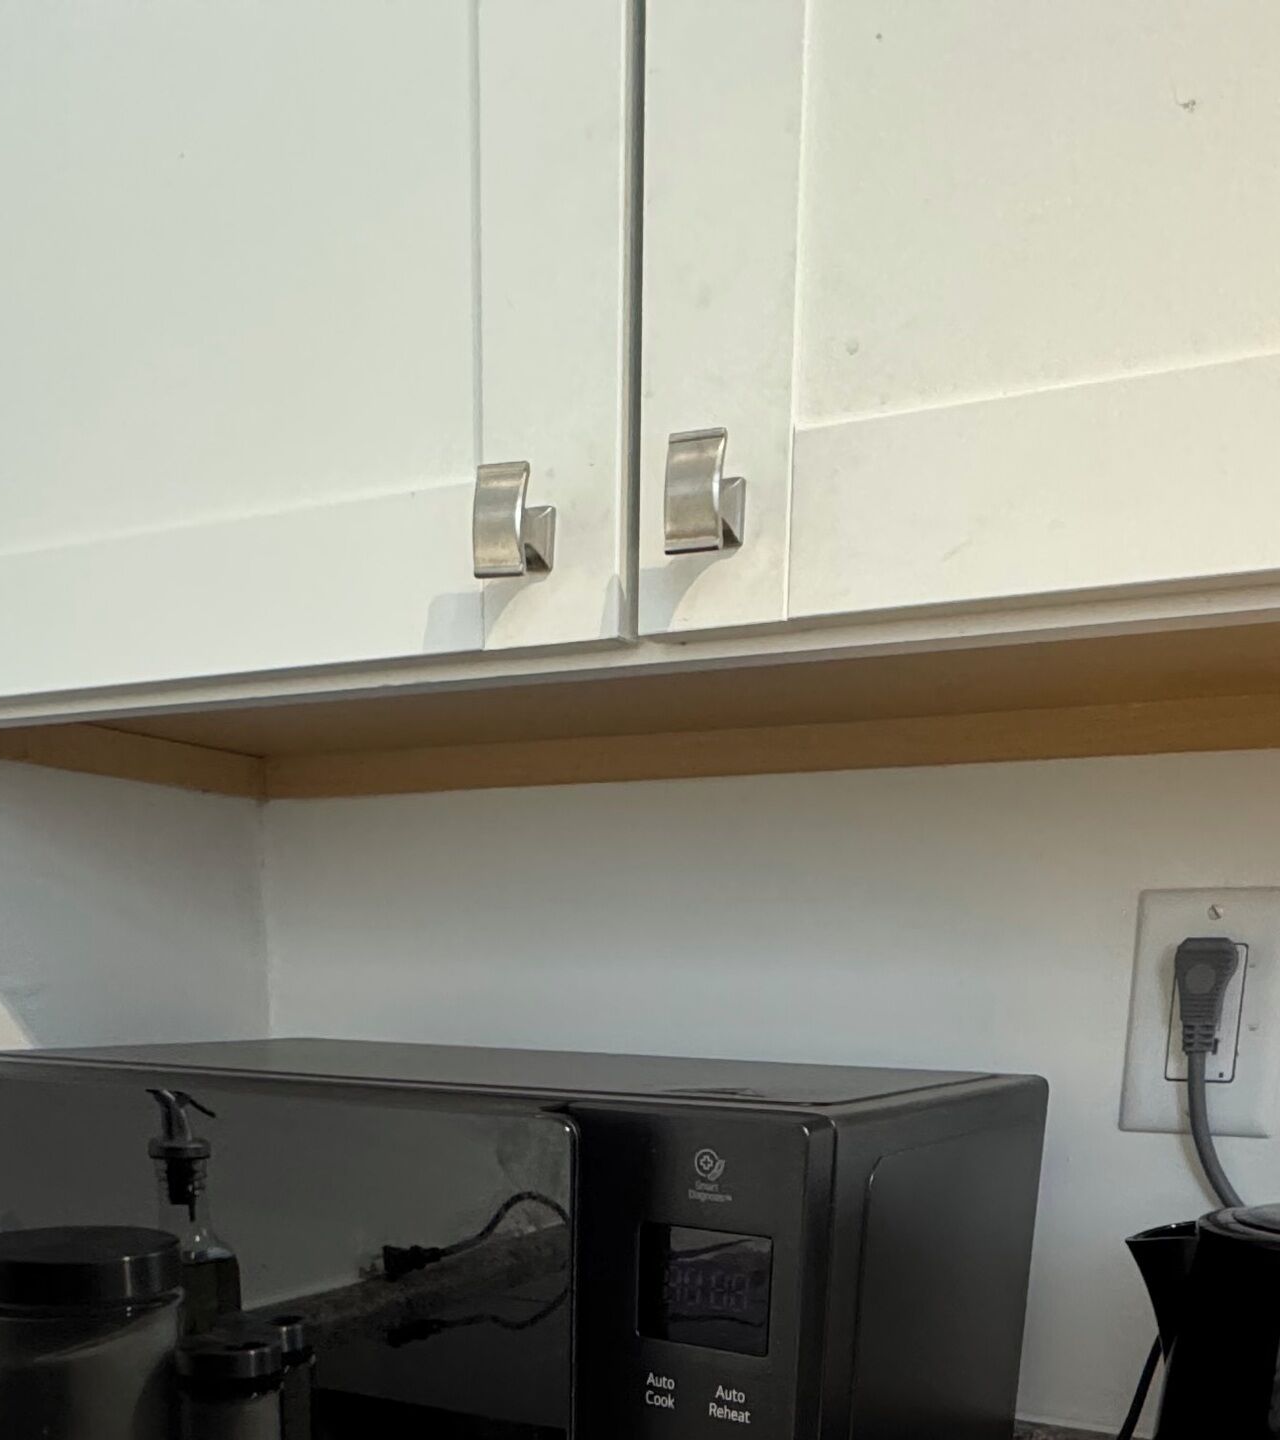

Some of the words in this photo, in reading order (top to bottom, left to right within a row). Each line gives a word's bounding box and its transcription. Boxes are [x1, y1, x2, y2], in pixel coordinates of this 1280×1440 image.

[646, 1372, 675, 1390] Auto
[645, 1390, 675, 1409] Cook
[715, 1385, 746, 1403] Auto
[709, 1402, 751, 1424] Reheat
